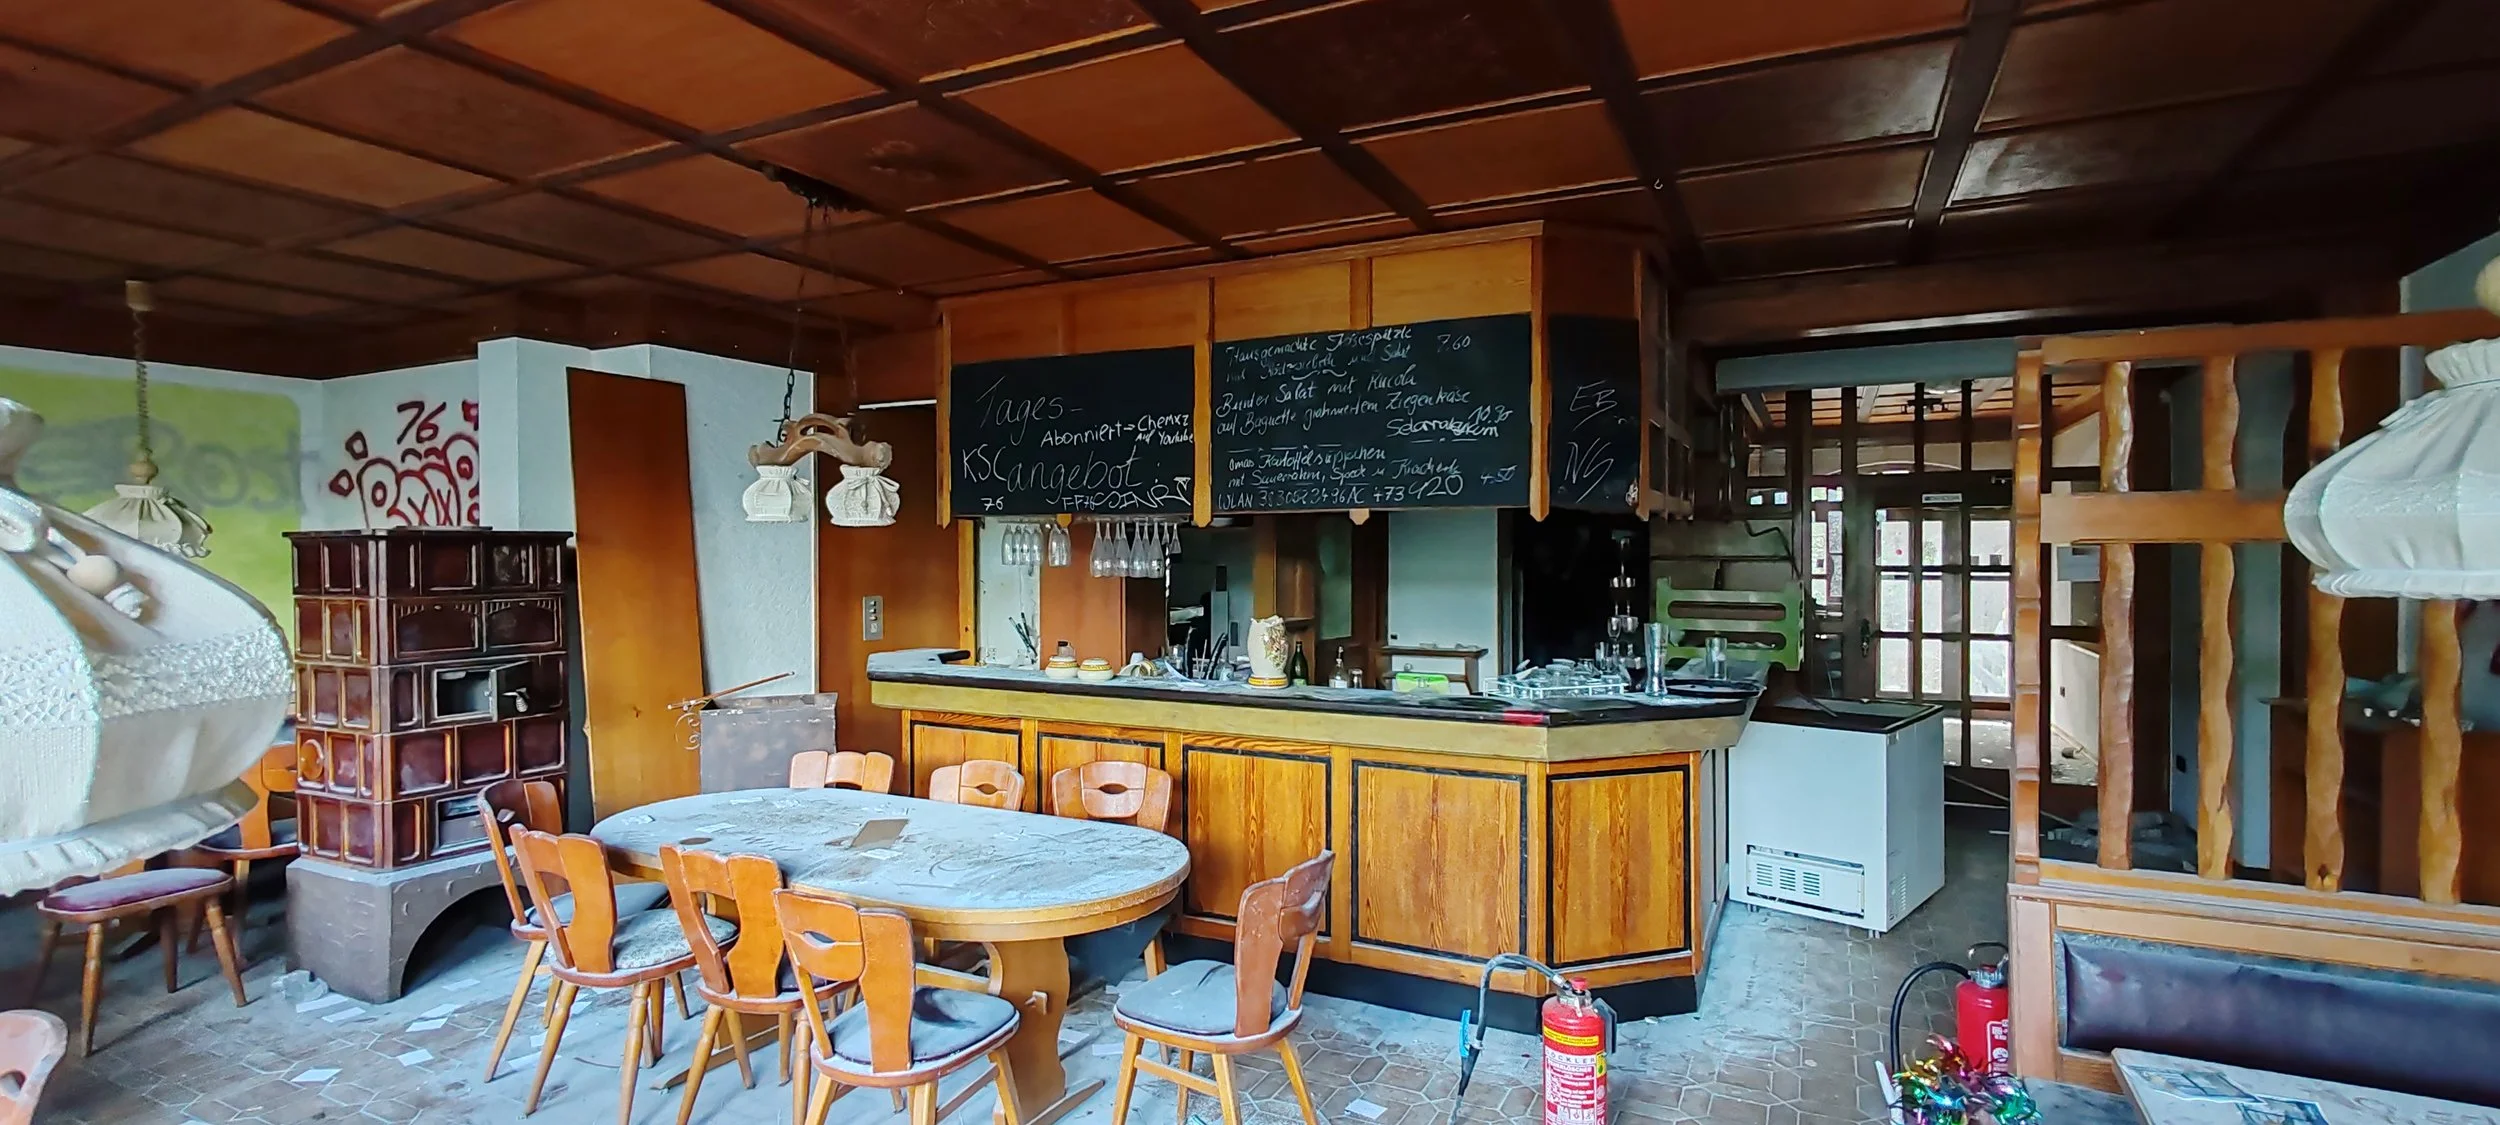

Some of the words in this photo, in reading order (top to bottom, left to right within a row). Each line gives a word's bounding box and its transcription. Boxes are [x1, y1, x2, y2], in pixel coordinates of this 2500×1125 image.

[1275, 381, 1317, 403] Salat
[1328, 378, 1357, 394] mit
[1367, 363, 1417, 392] Rucola
[397, 400, 447, 445] 76
[1216, 413, 1237, 436] auf
[1239, 411, 1297, 436] Baguette
[1041, 423, 1122, 448] Abonniert
[963, 443, 1007, 482] KSC
[1409, 474, 1463, 499] 420
[981, 497, 1004, 511] 76
